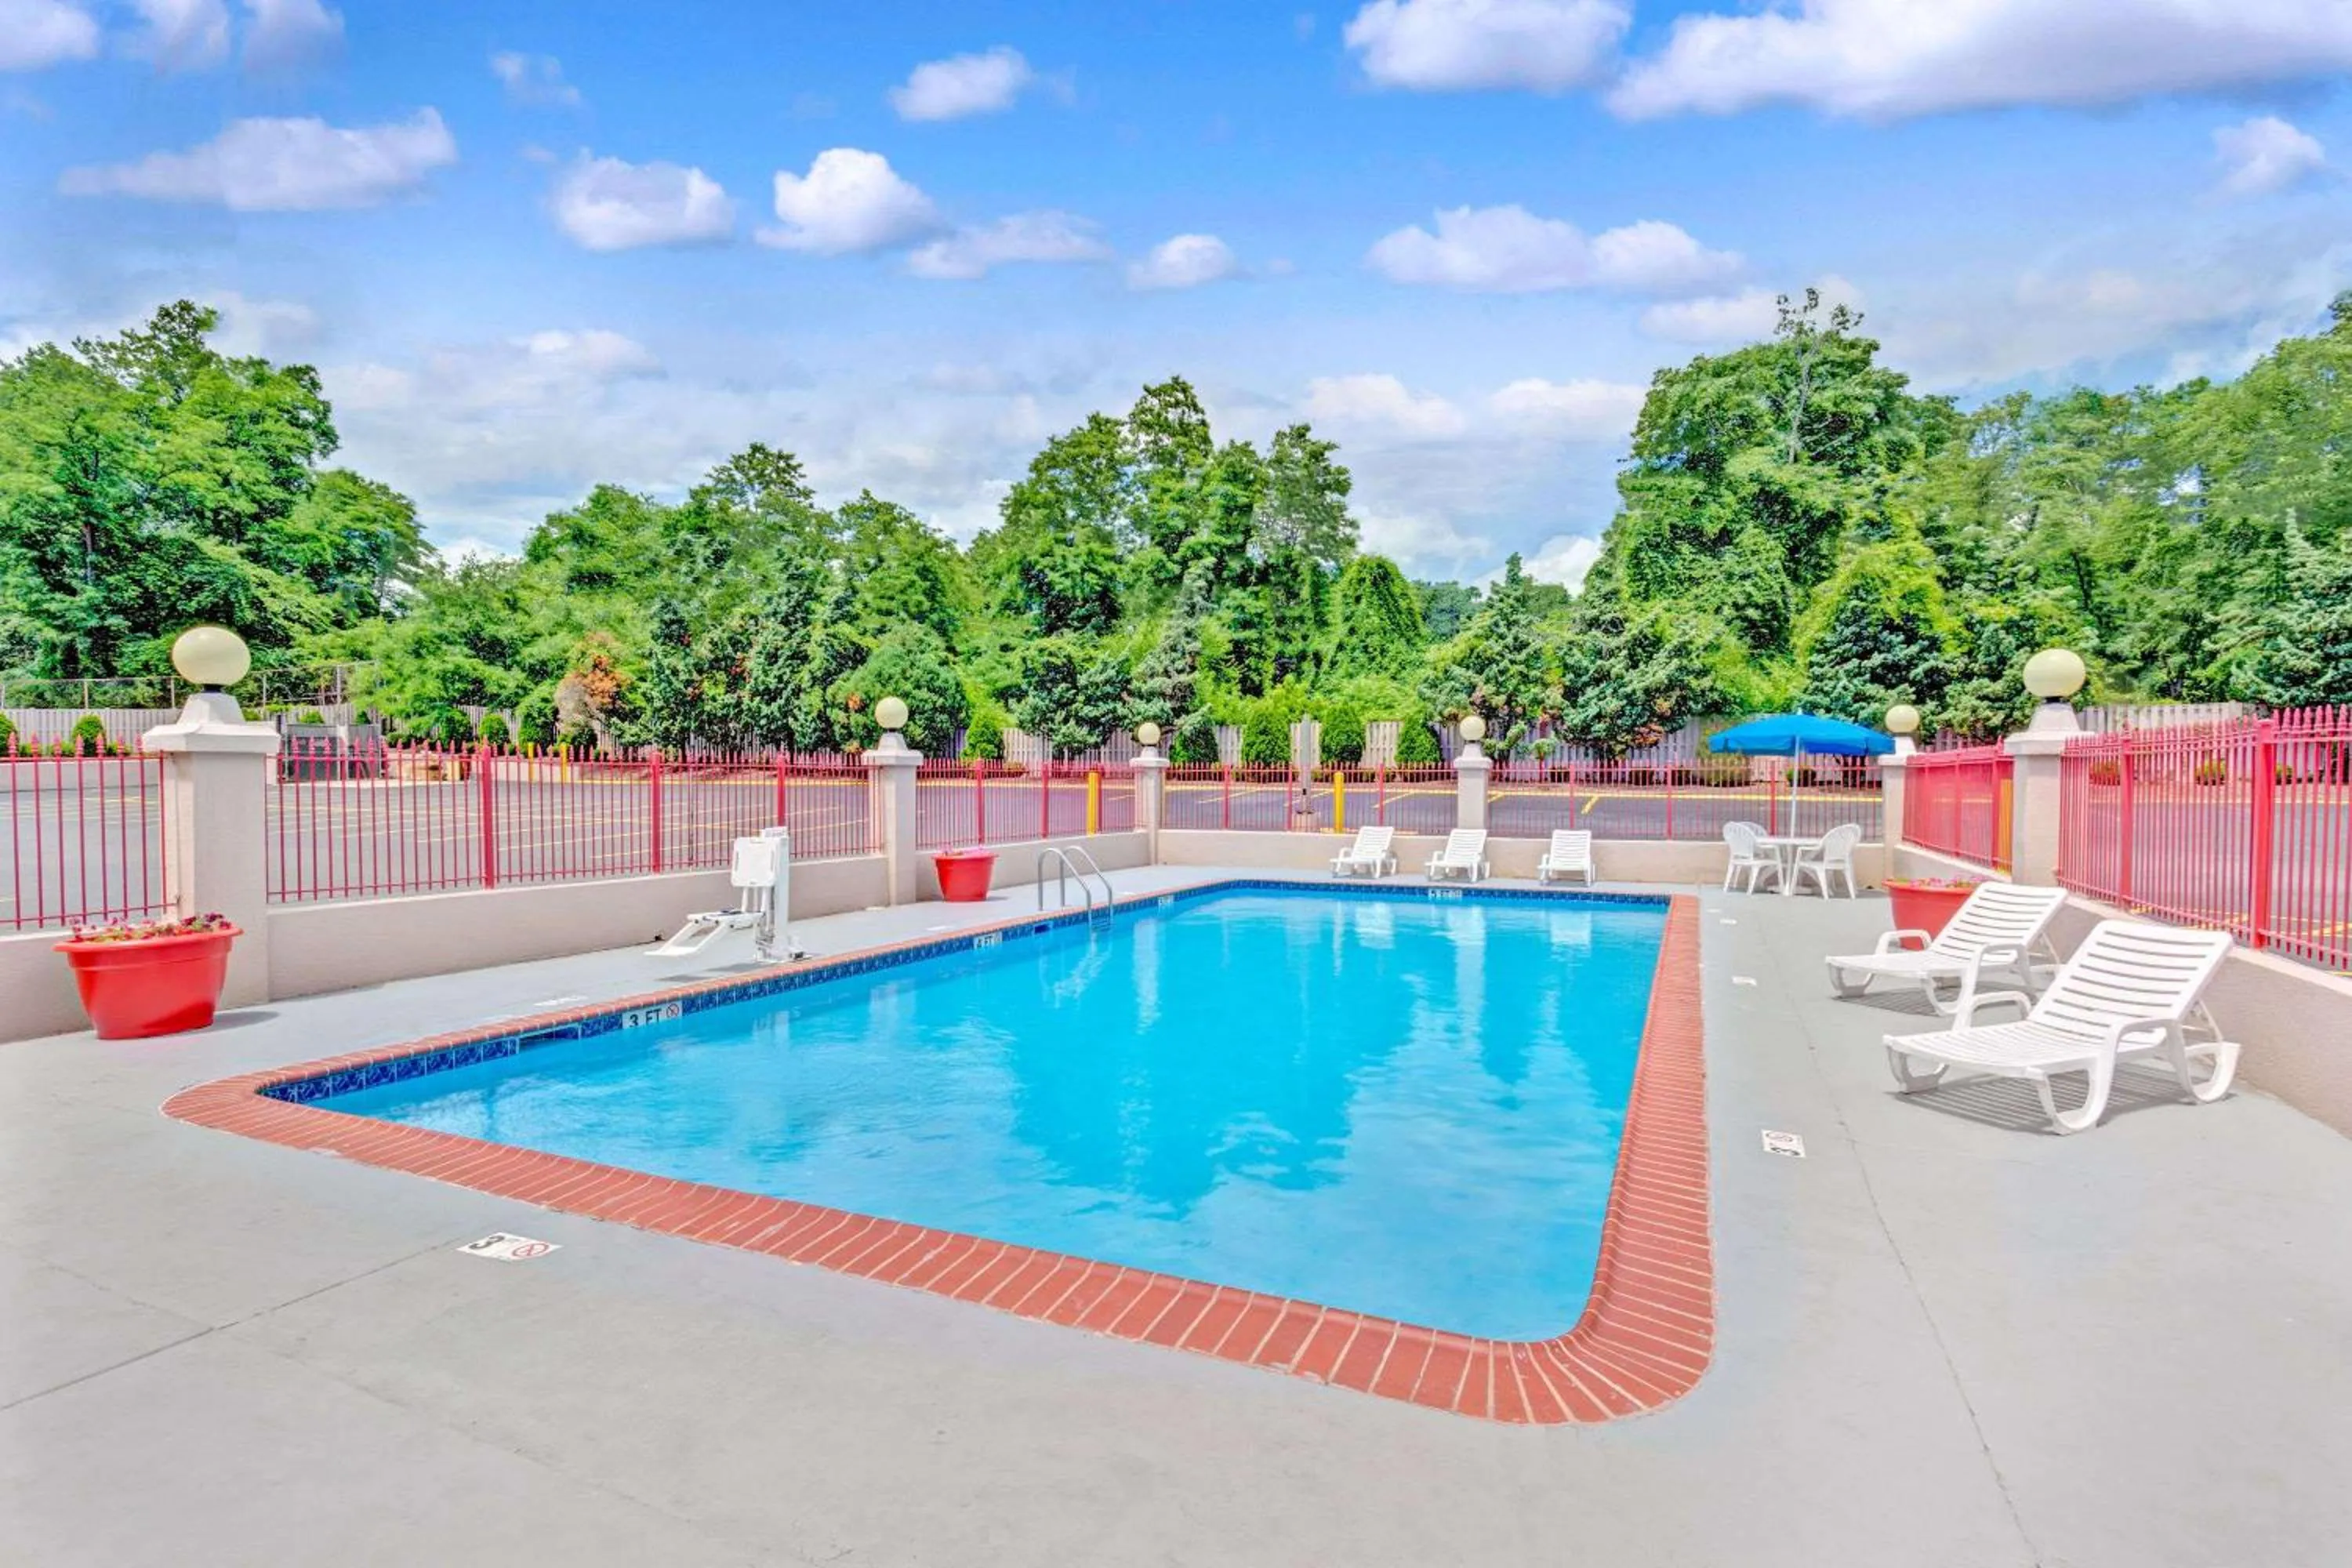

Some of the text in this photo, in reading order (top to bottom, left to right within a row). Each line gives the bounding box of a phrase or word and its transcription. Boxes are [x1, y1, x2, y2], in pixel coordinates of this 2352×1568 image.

[630, 1007, 662, 1027] 3 FT
[469, 1235, 505, 1250] 3
